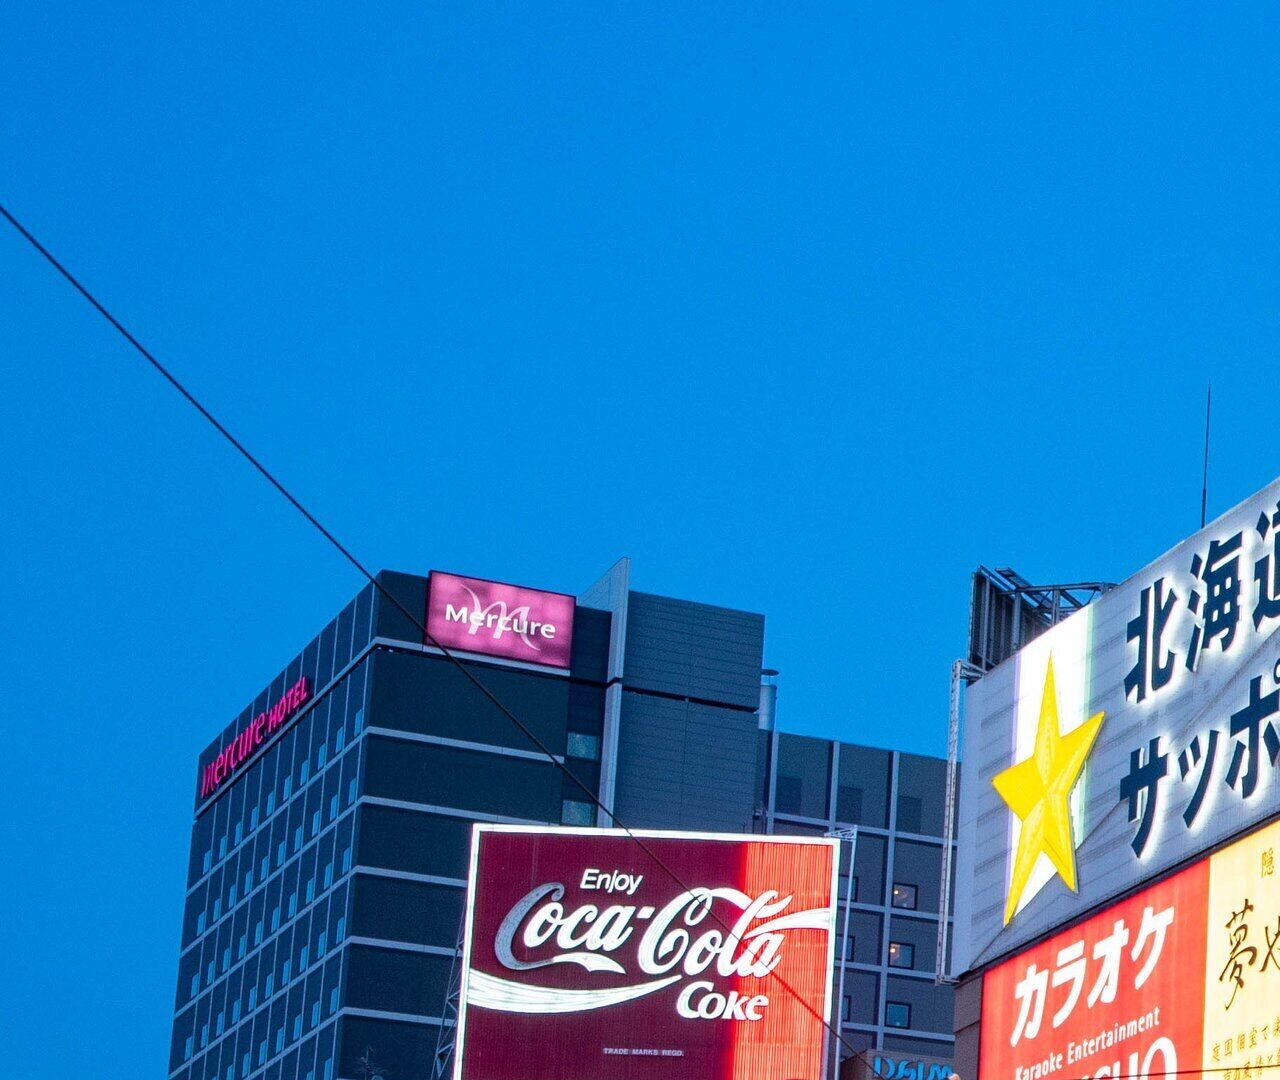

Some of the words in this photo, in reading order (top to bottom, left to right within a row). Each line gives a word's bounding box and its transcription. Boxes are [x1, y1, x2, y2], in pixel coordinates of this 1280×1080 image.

[445, 604, 556, 640] Mercure
[268, 676, 309, 733] HOTEL
[580, 868, 643, 895] Enjoy
[494, 881, 793, 979] Coca-Cola
[1010, 902, 1175, 1047] カラオケ
[676, 981, 769, 1021] Coke
[603, 1048, 629, 1056] TRADE
[632, 1048, 658, 1056] MARKS
[1067, 1007, 1160, 1065] Entertainment
